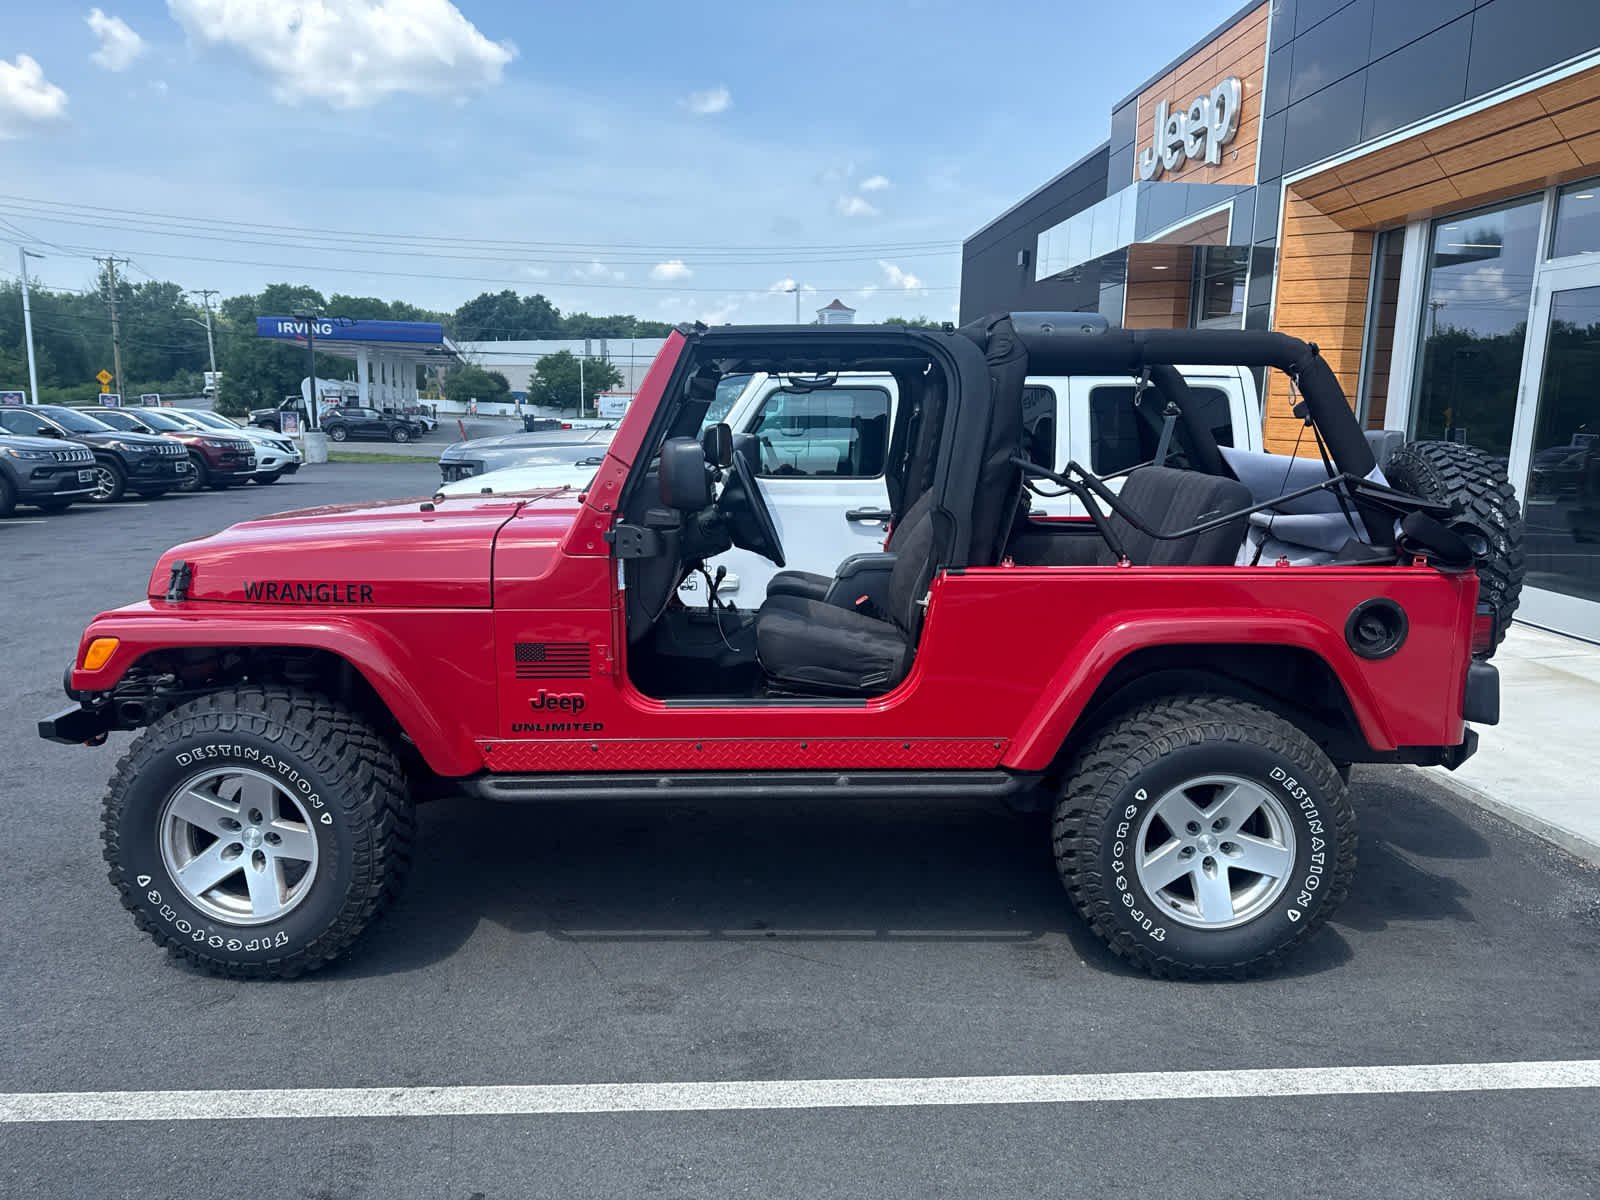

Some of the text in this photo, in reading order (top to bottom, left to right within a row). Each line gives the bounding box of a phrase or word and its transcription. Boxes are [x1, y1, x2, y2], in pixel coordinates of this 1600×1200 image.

[1138, 76, 1242, 181] Jeep
[277, 321, 333, 335] IRVING
[243, 580, 374, 603] WRANGLER
[528, 688, 586, 714] Jeep
[511, 722, 604, 732] UNLIMITED
[176, 744, 325, 809] DESTINATION
[1269, 766, 1326, 908] DESTINATION
[1111, 803, 1168, 943] Firestone
